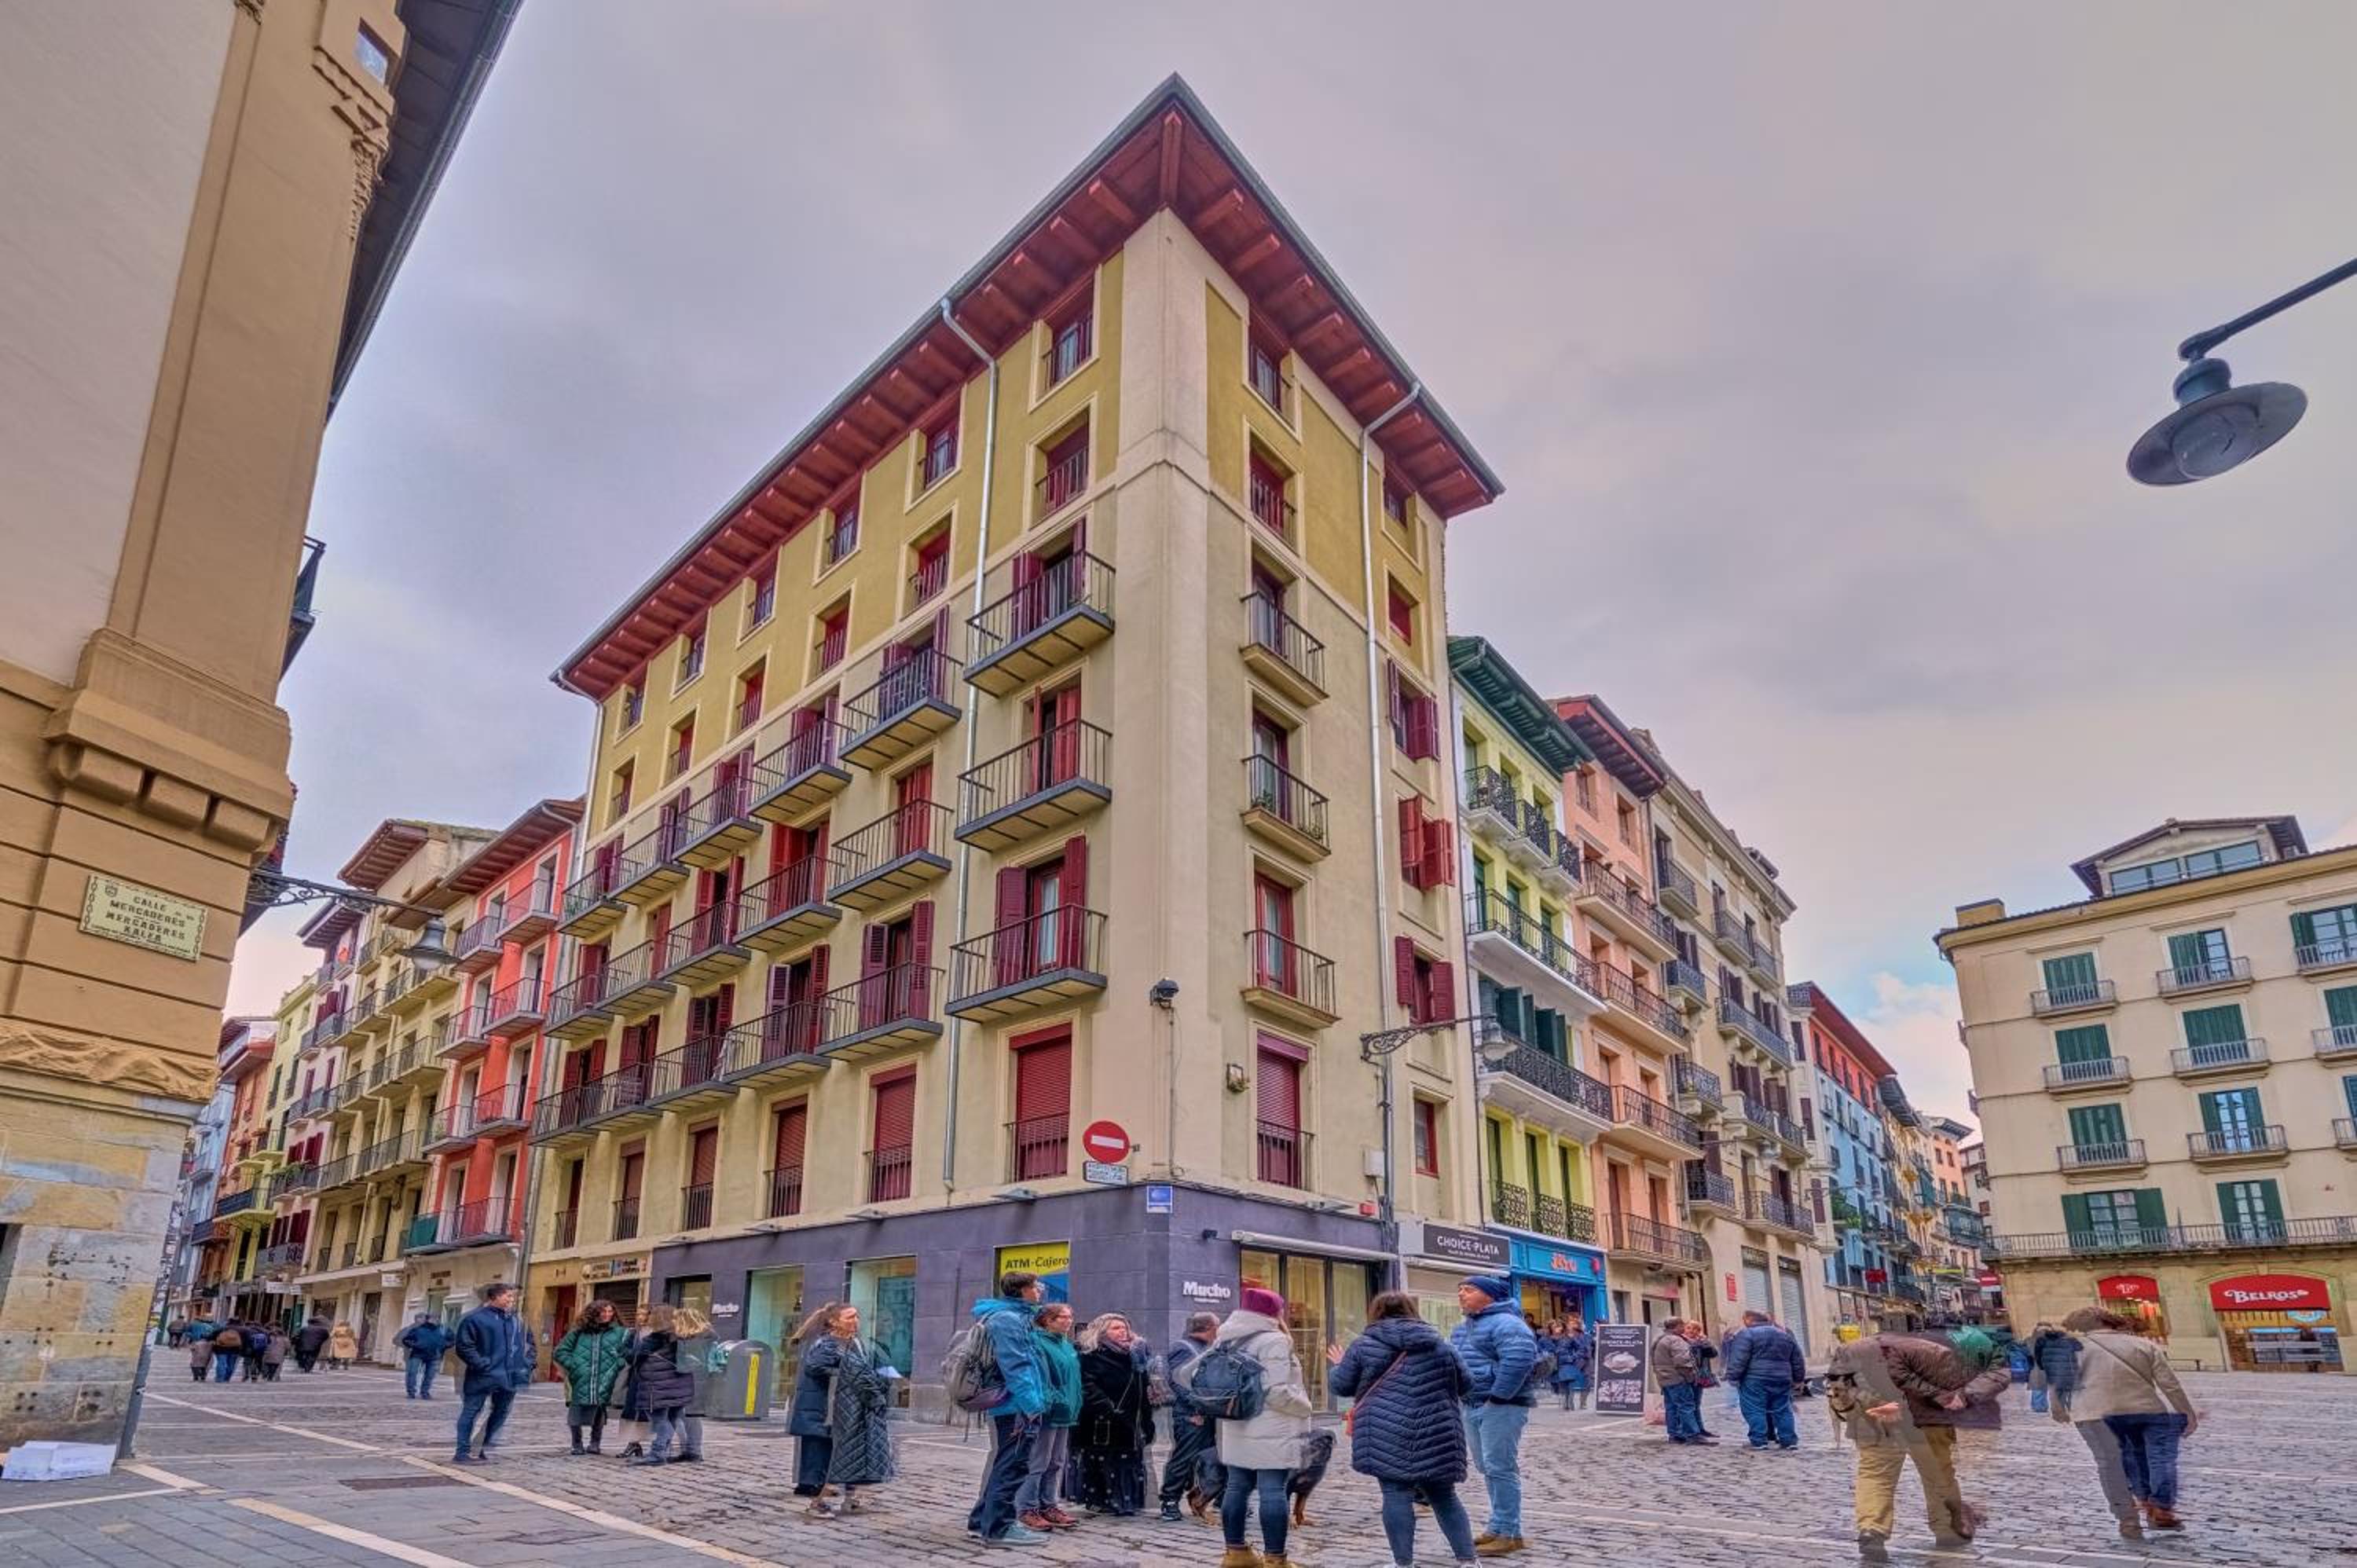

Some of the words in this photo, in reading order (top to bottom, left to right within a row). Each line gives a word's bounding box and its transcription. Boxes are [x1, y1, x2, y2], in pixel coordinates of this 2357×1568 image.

[133, 896, 167, 912] CALLE
[109, 899, 185, 928] MERCADERES
[105, 911, 185, 940] MERCADERES
[123, 925, 162, 942] KALEA
[1182, 1280, 1232, 1299] Mucho
[2224, 1288, 2300, 1304] BELROS
